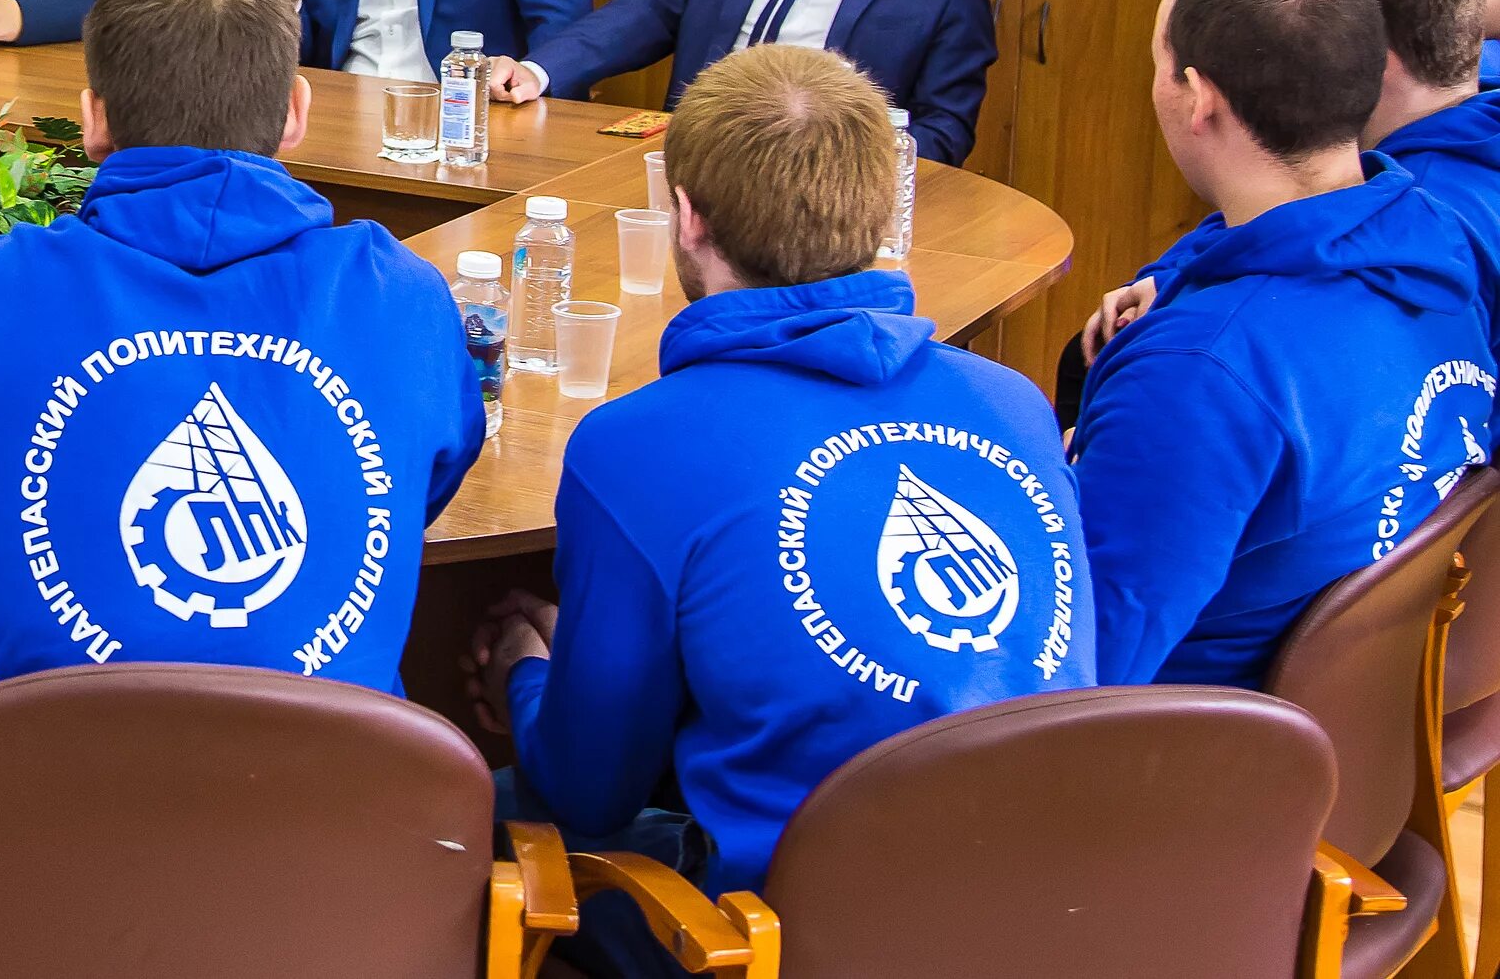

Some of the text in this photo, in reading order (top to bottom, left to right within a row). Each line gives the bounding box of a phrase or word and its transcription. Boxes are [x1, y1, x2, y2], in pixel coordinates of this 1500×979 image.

[20, 329, 393, 677] ЛАНГЕПАССКИЙ ПОЛИТЕХНИЧЕСКИЙ КОЛЛЕДЖ
[777, 421, 1073, 704] ЛАНГЕПАССКИЙ ПОЛИТЕХНИЧЕСКИЙ КОЛЛЕДЖ
